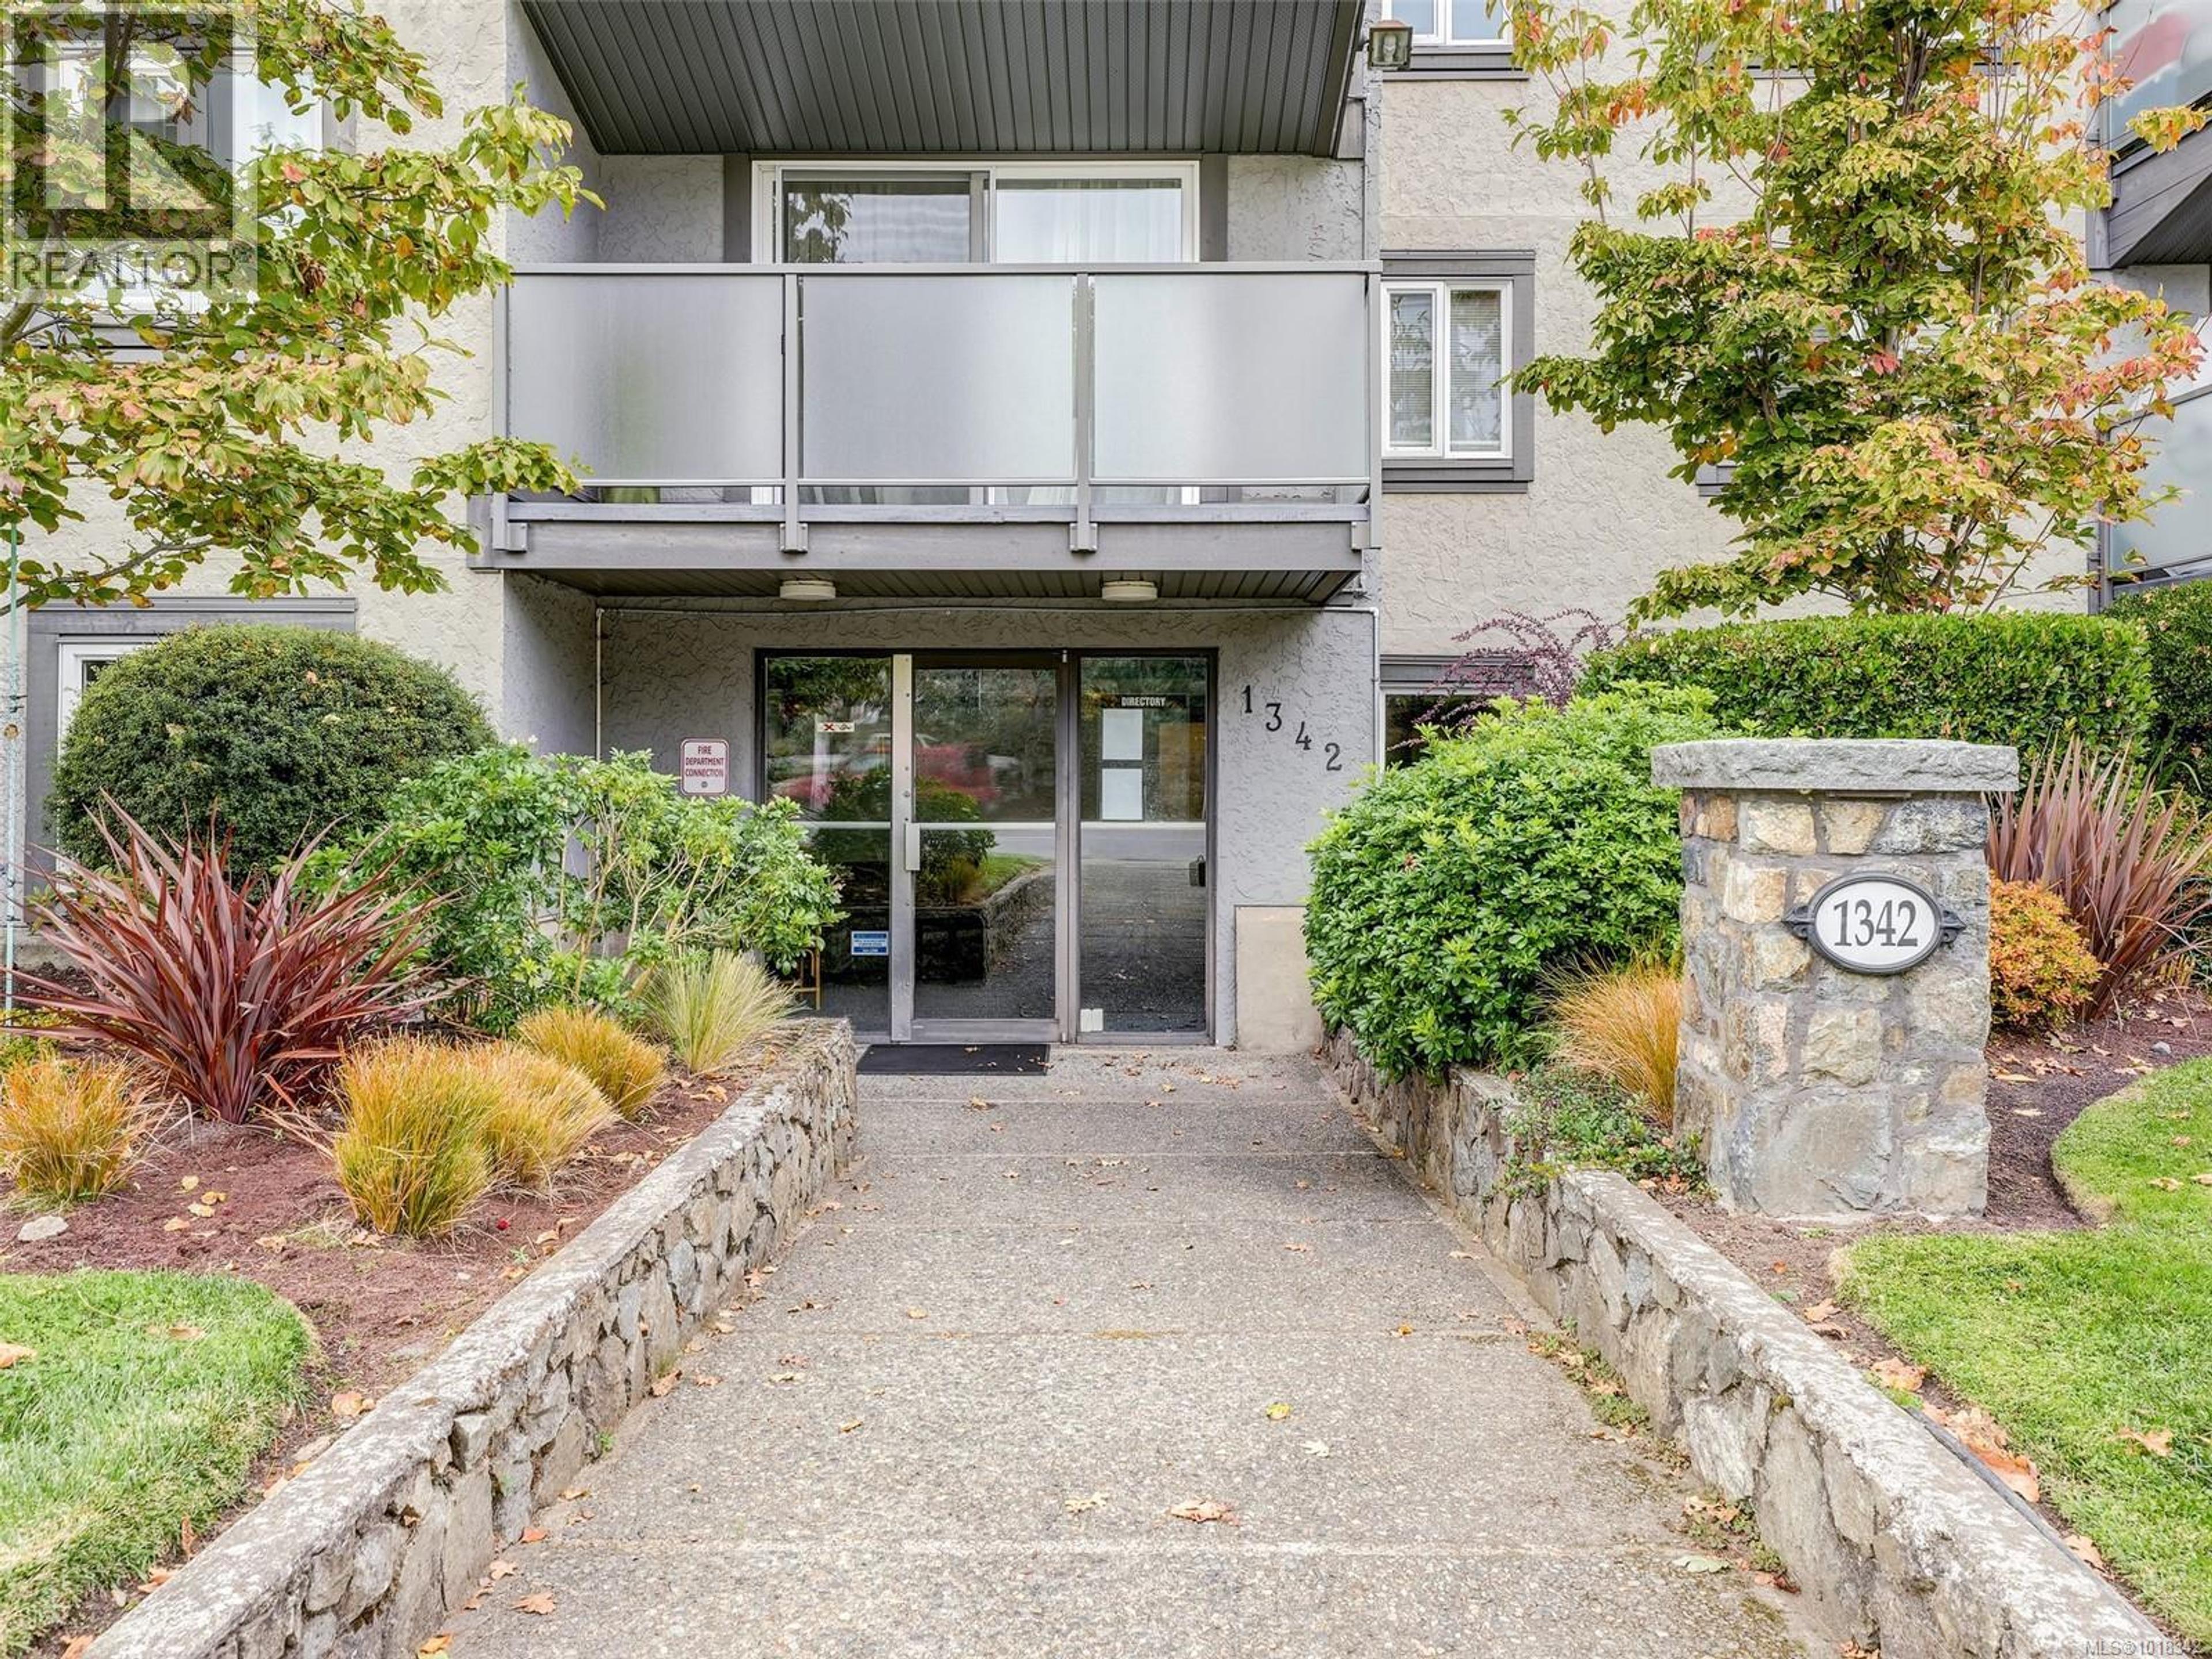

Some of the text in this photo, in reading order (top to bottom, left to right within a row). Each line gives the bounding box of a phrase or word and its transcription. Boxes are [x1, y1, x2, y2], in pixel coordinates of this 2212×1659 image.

[1121, 696, 1166, 707] DIRECTORY
[1241, 684, 1343, 771] 1342
[698, 745, 711, 755] FIRE
[685, 757, 724, 766] DEPARTMENT
[685, 768, 724, 777] CONNECTION
[1833, 899, 1918, 947] 1342
